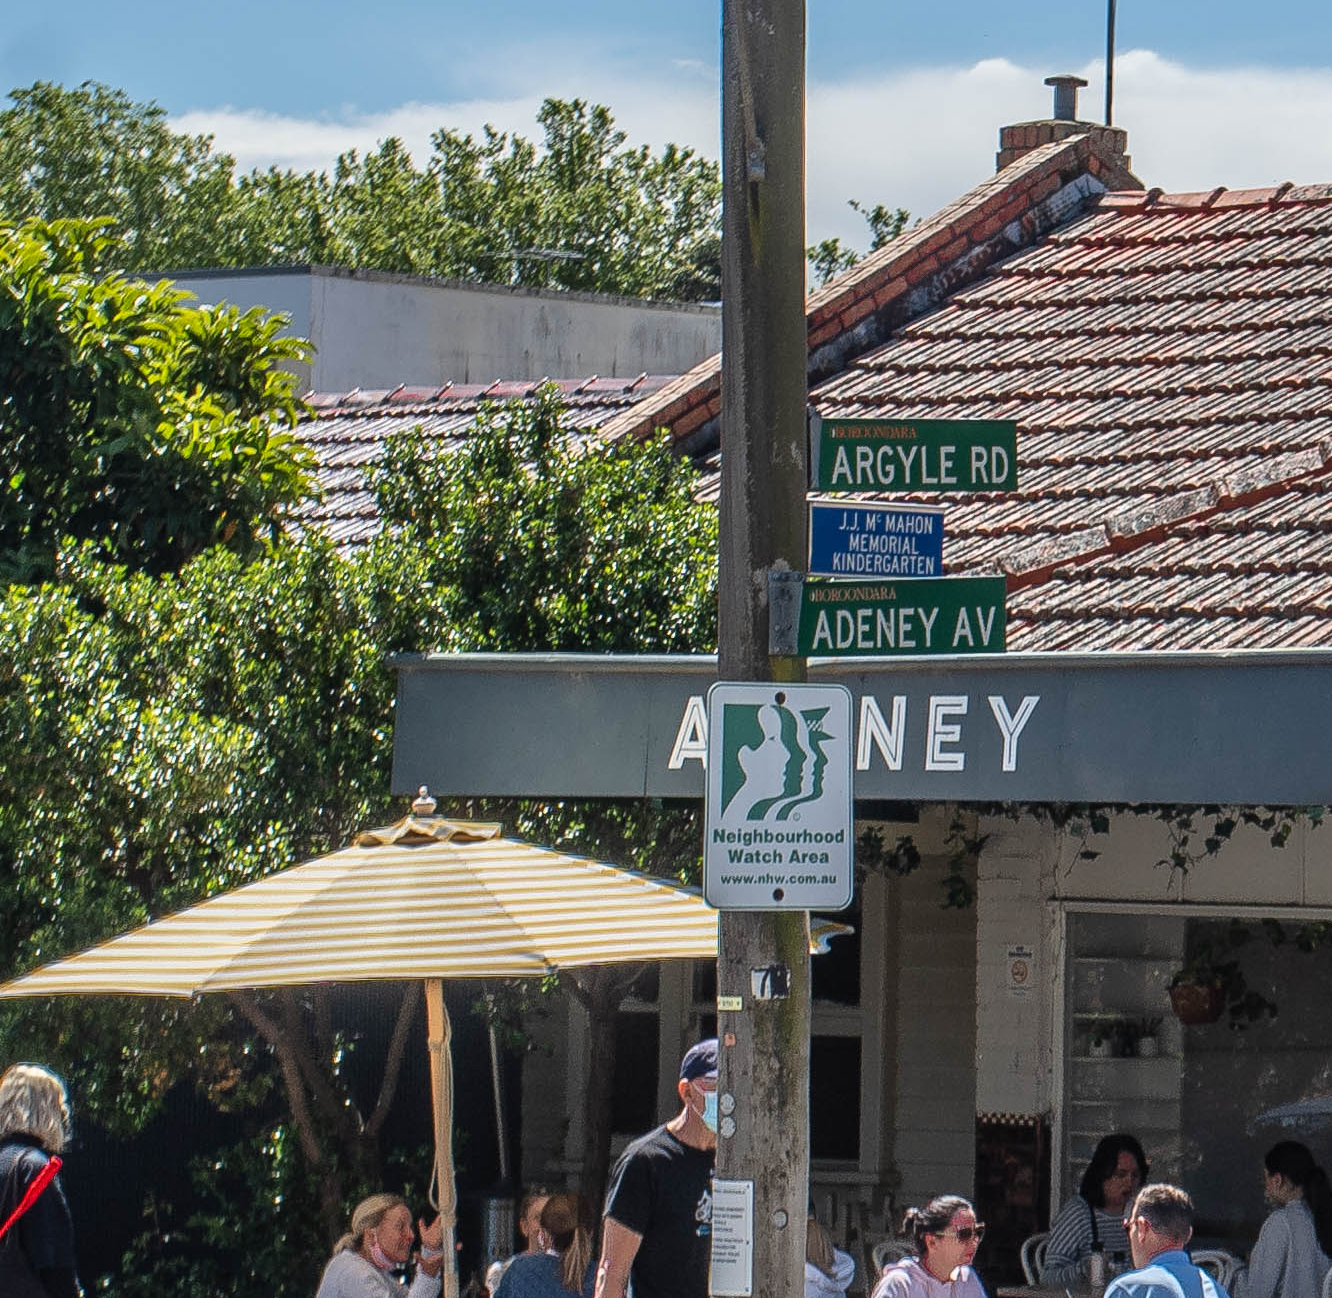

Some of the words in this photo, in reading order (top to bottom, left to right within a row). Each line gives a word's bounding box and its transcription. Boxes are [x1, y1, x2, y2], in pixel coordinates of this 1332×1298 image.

[831, 445, 957, 484] ARGYLE
[970, 445, 1009, 484] RD
[839, 513, 860, 531] J.J.
[885, 514, 933, 535] MAHON
[849, 534, 919, 555] MEMORIAL
[832, 554, 935, 575] KINDERGARTEN
[812, 607, 939, 649] ADENEY
[952, 606, 996, 648] AV
[667, 696, 1040, 772] ANEY
[713, 829, 845, 846] Neighbourhood
[728, 849, 783, 864] Watch
[788, 849, 830, 864] Area
[720, 874, 837, 885] www.nhw.com.au
